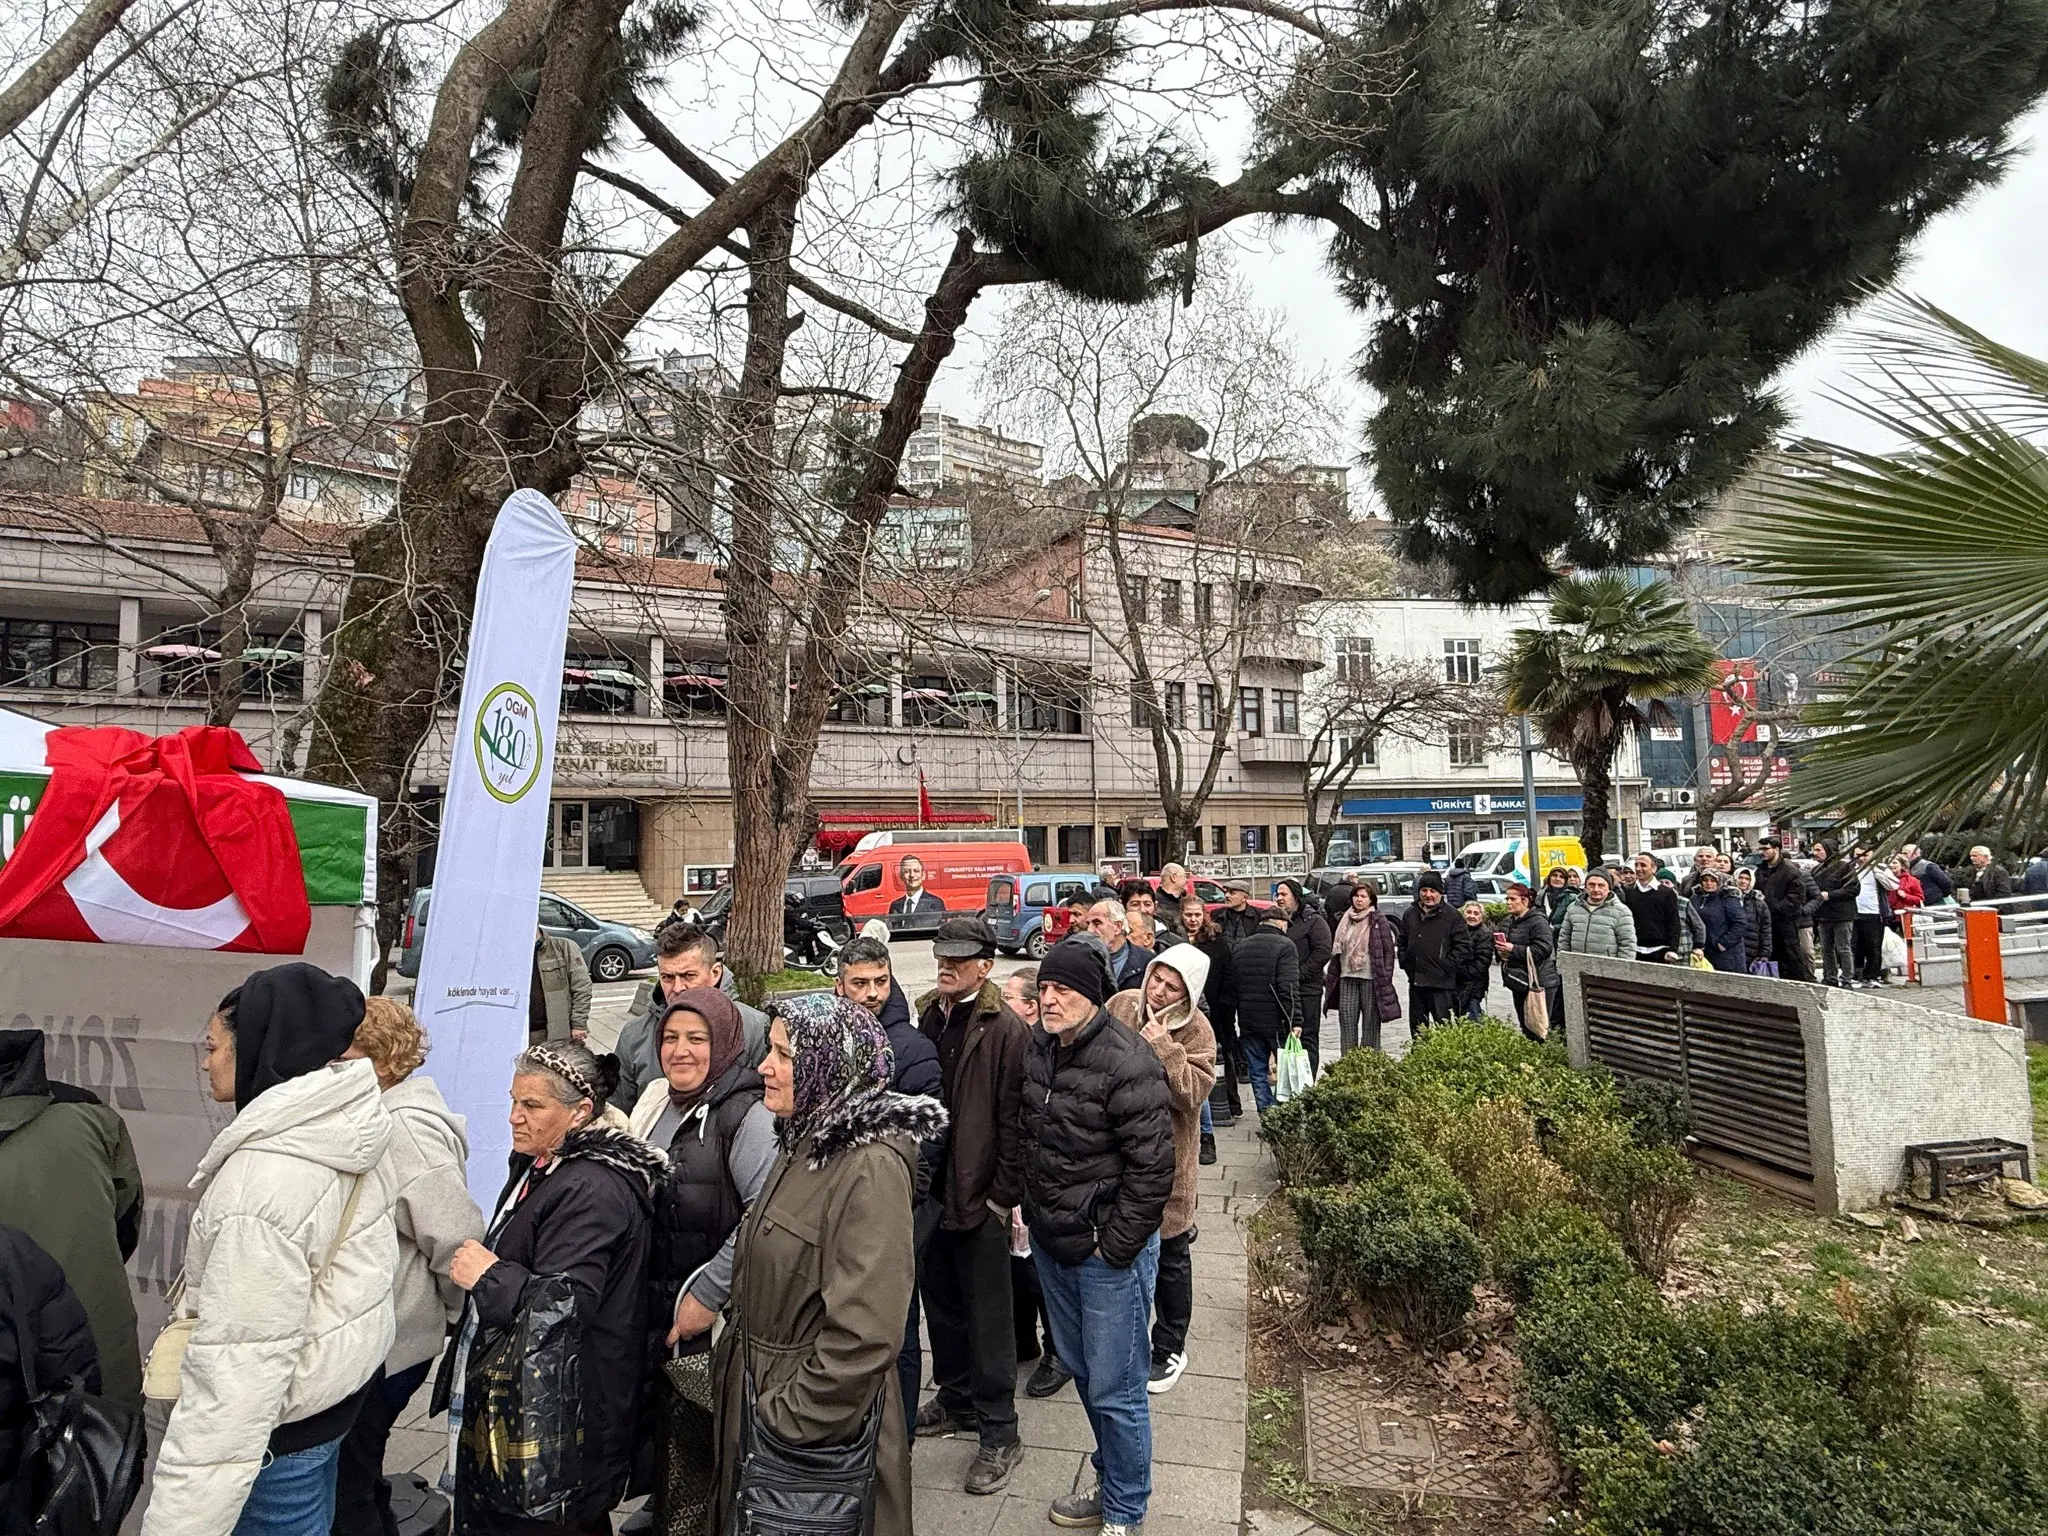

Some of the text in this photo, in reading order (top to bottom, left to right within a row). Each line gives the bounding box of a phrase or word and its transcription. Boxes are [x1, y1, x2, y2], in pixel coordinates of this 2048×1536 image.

[505, 697, 528, 720] OGM
[493, 707, 526, 769] 180
[1430, 799, 1473, 810] TÜRKİYE
[1490, 800, 1527, 809] BANKAS
[1549, 849, 1567, 866] Ptt
[478, 985, 498, 998] hayat
